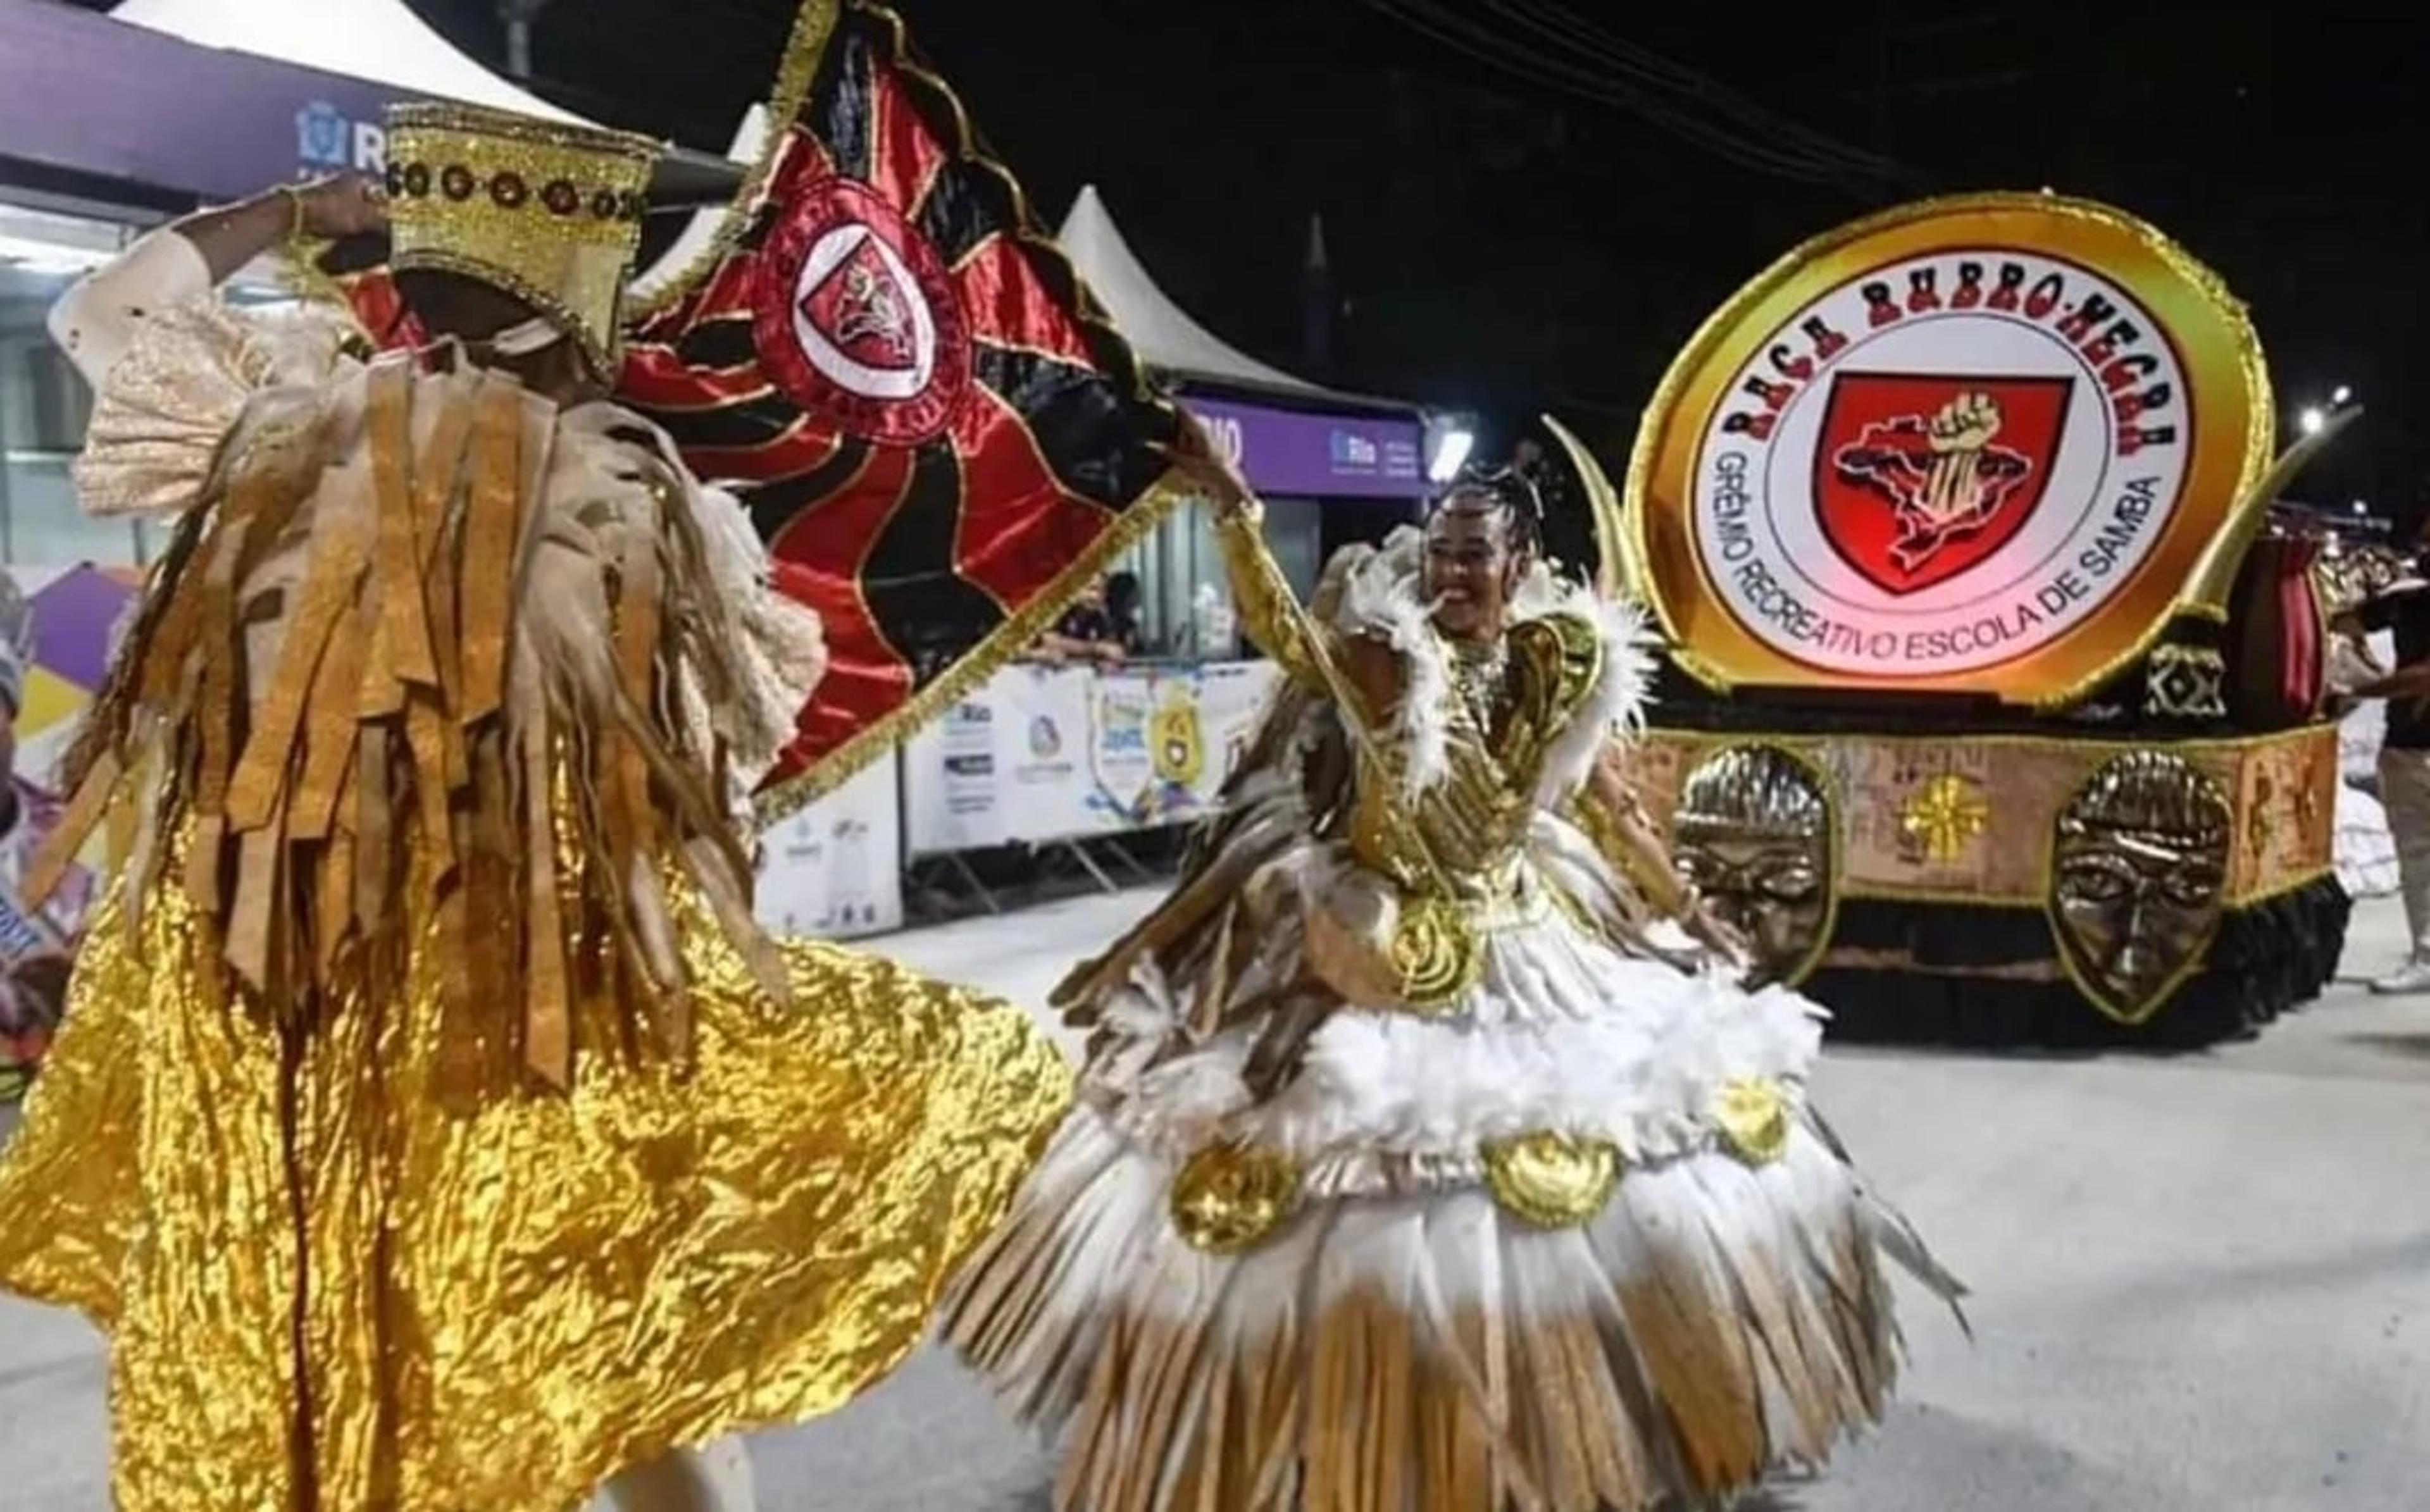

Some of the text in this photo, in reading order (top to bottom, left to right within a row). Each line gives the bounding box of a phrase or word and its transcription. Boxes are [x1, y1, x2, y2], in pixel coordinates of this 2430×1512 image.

[1712, 451, 2163, 660] GRÊMIO RECREATIVO ESCOLA DE SAMBA
